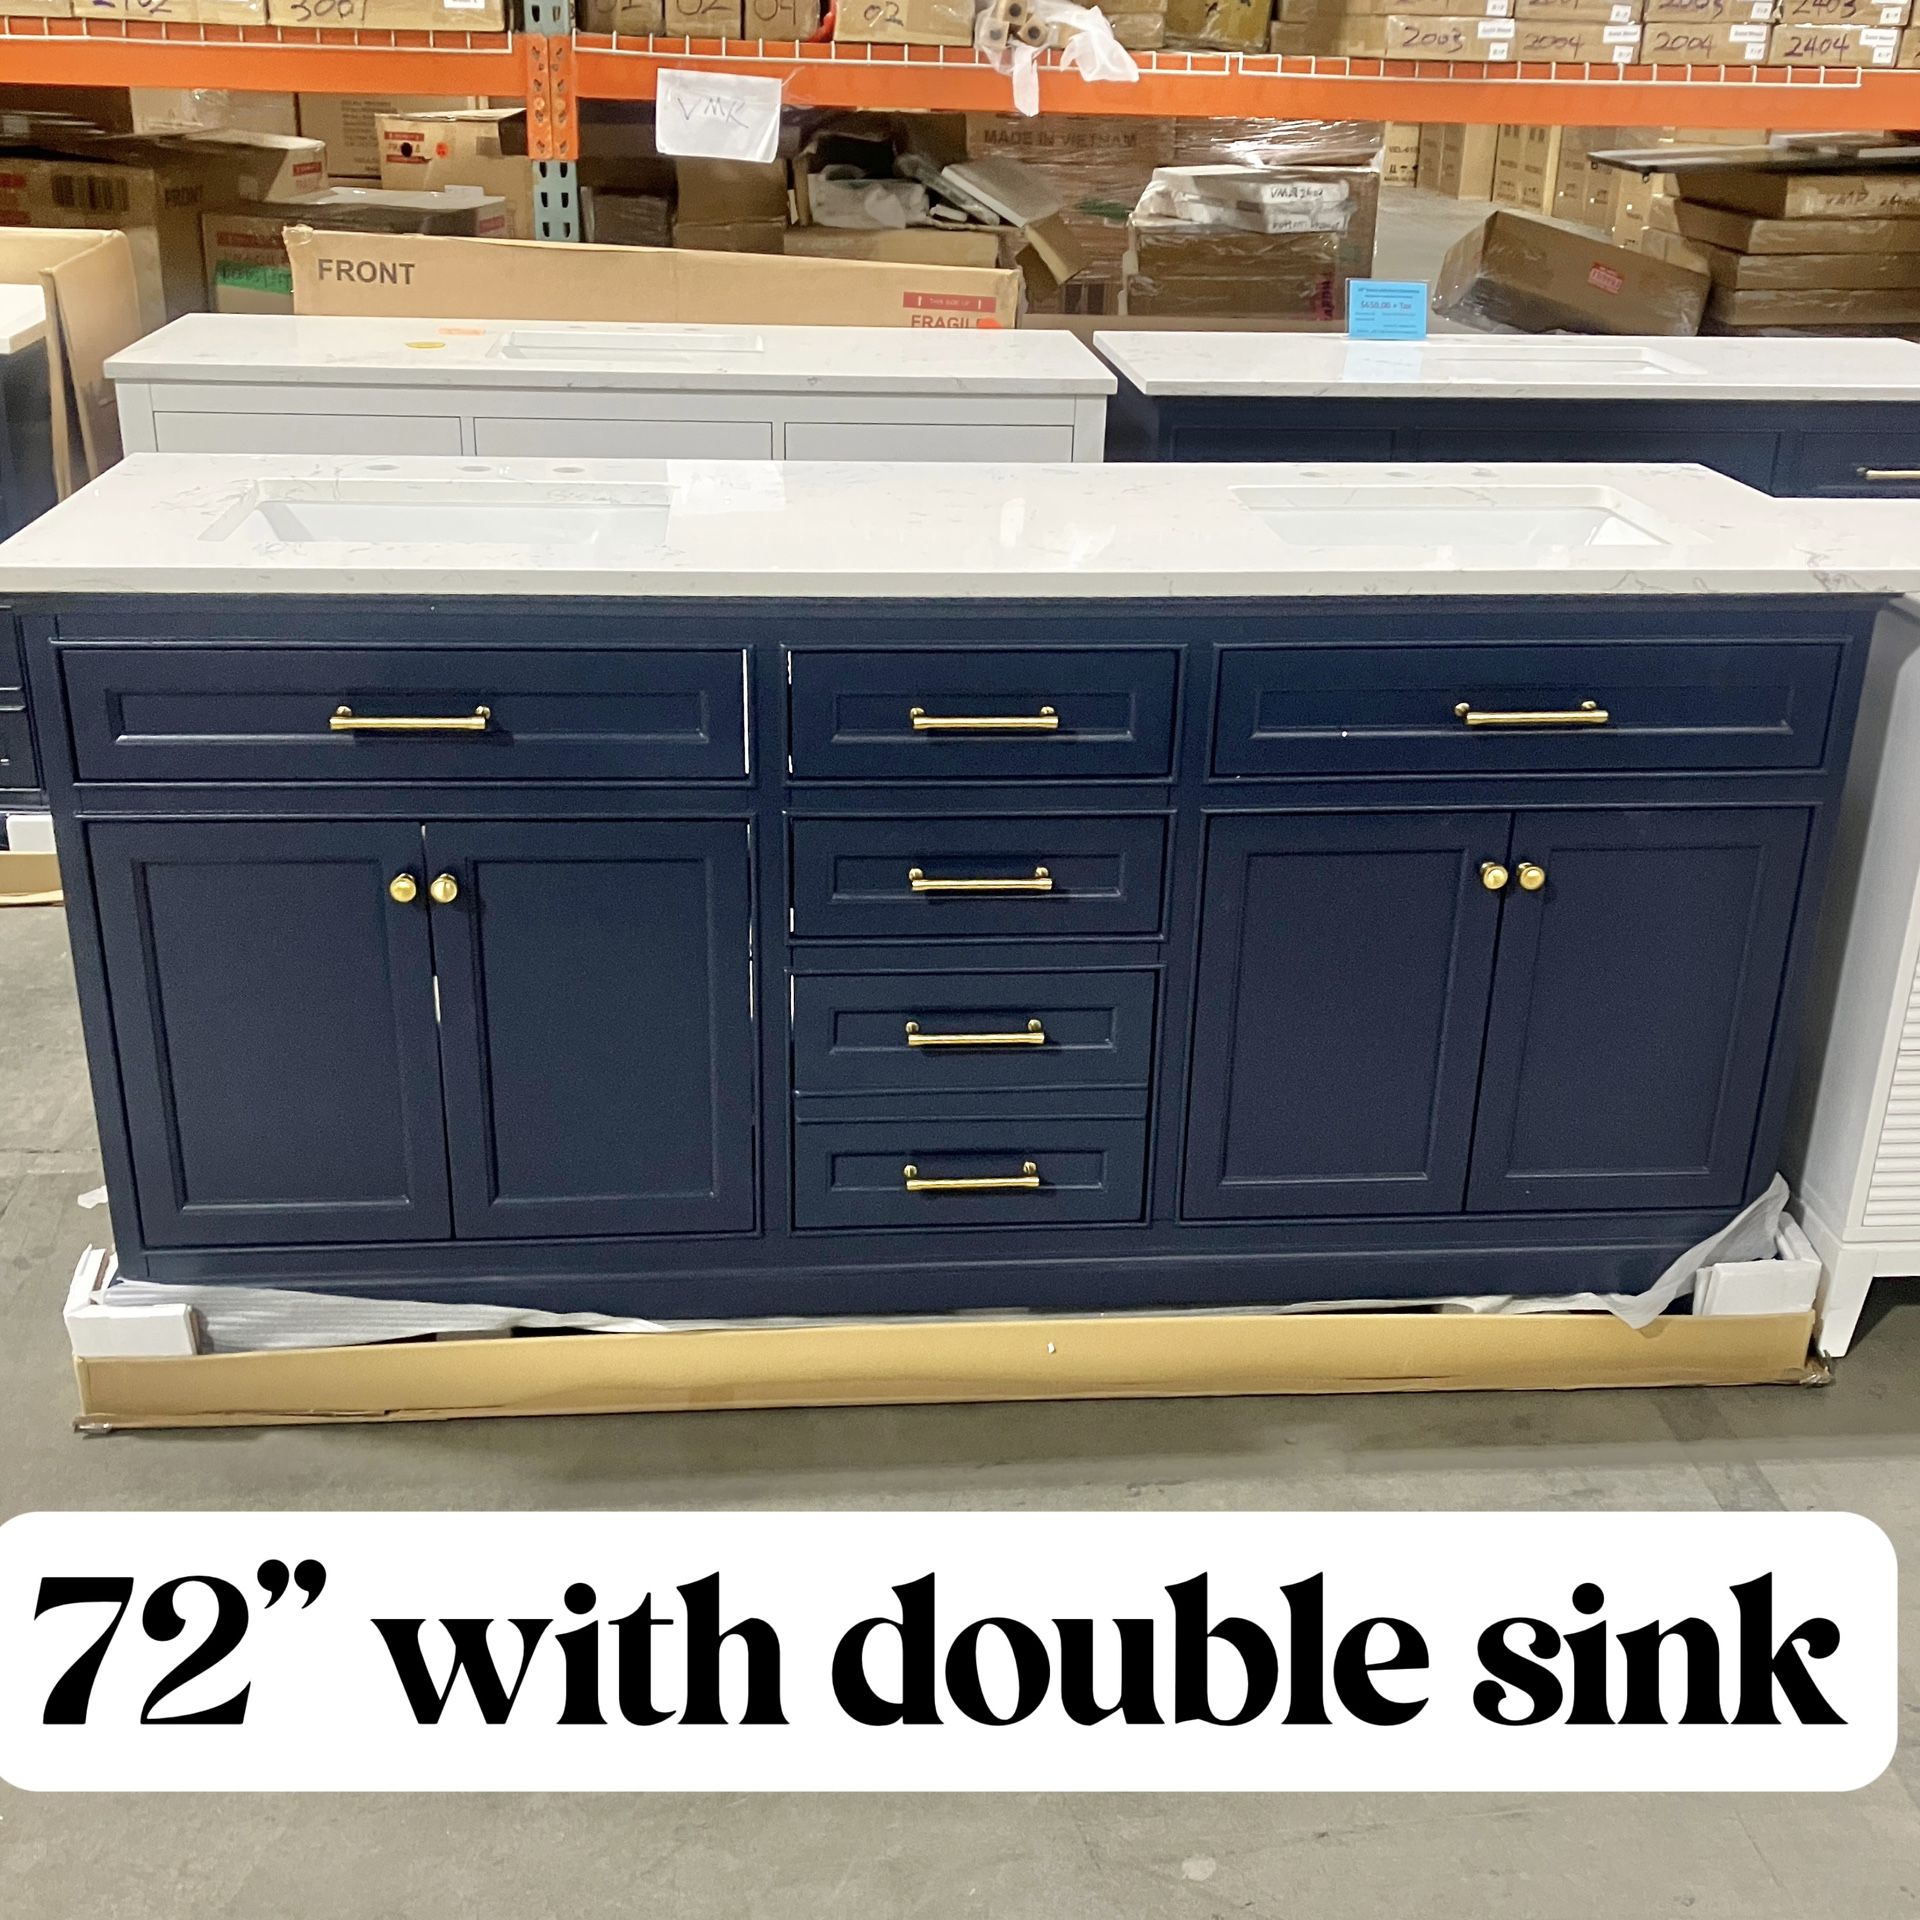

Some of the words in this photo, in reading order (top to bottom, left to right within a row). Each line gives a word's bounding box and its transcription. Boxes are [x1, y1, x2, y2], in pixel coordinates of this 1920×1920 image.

[1401, 26, 1464, 54] 2003
[1523, 33, 1584, 60] 2004
[1653, 31, 1713, 59] 2004
[1784, 33, 1850, 62] 2404
[983, 130, 1033, 146] MADE
[1039, 132, 1054, 147] IN
[318, 257, 415, 285] FRONT
[911, 314, 987, 329] FRAGIL
